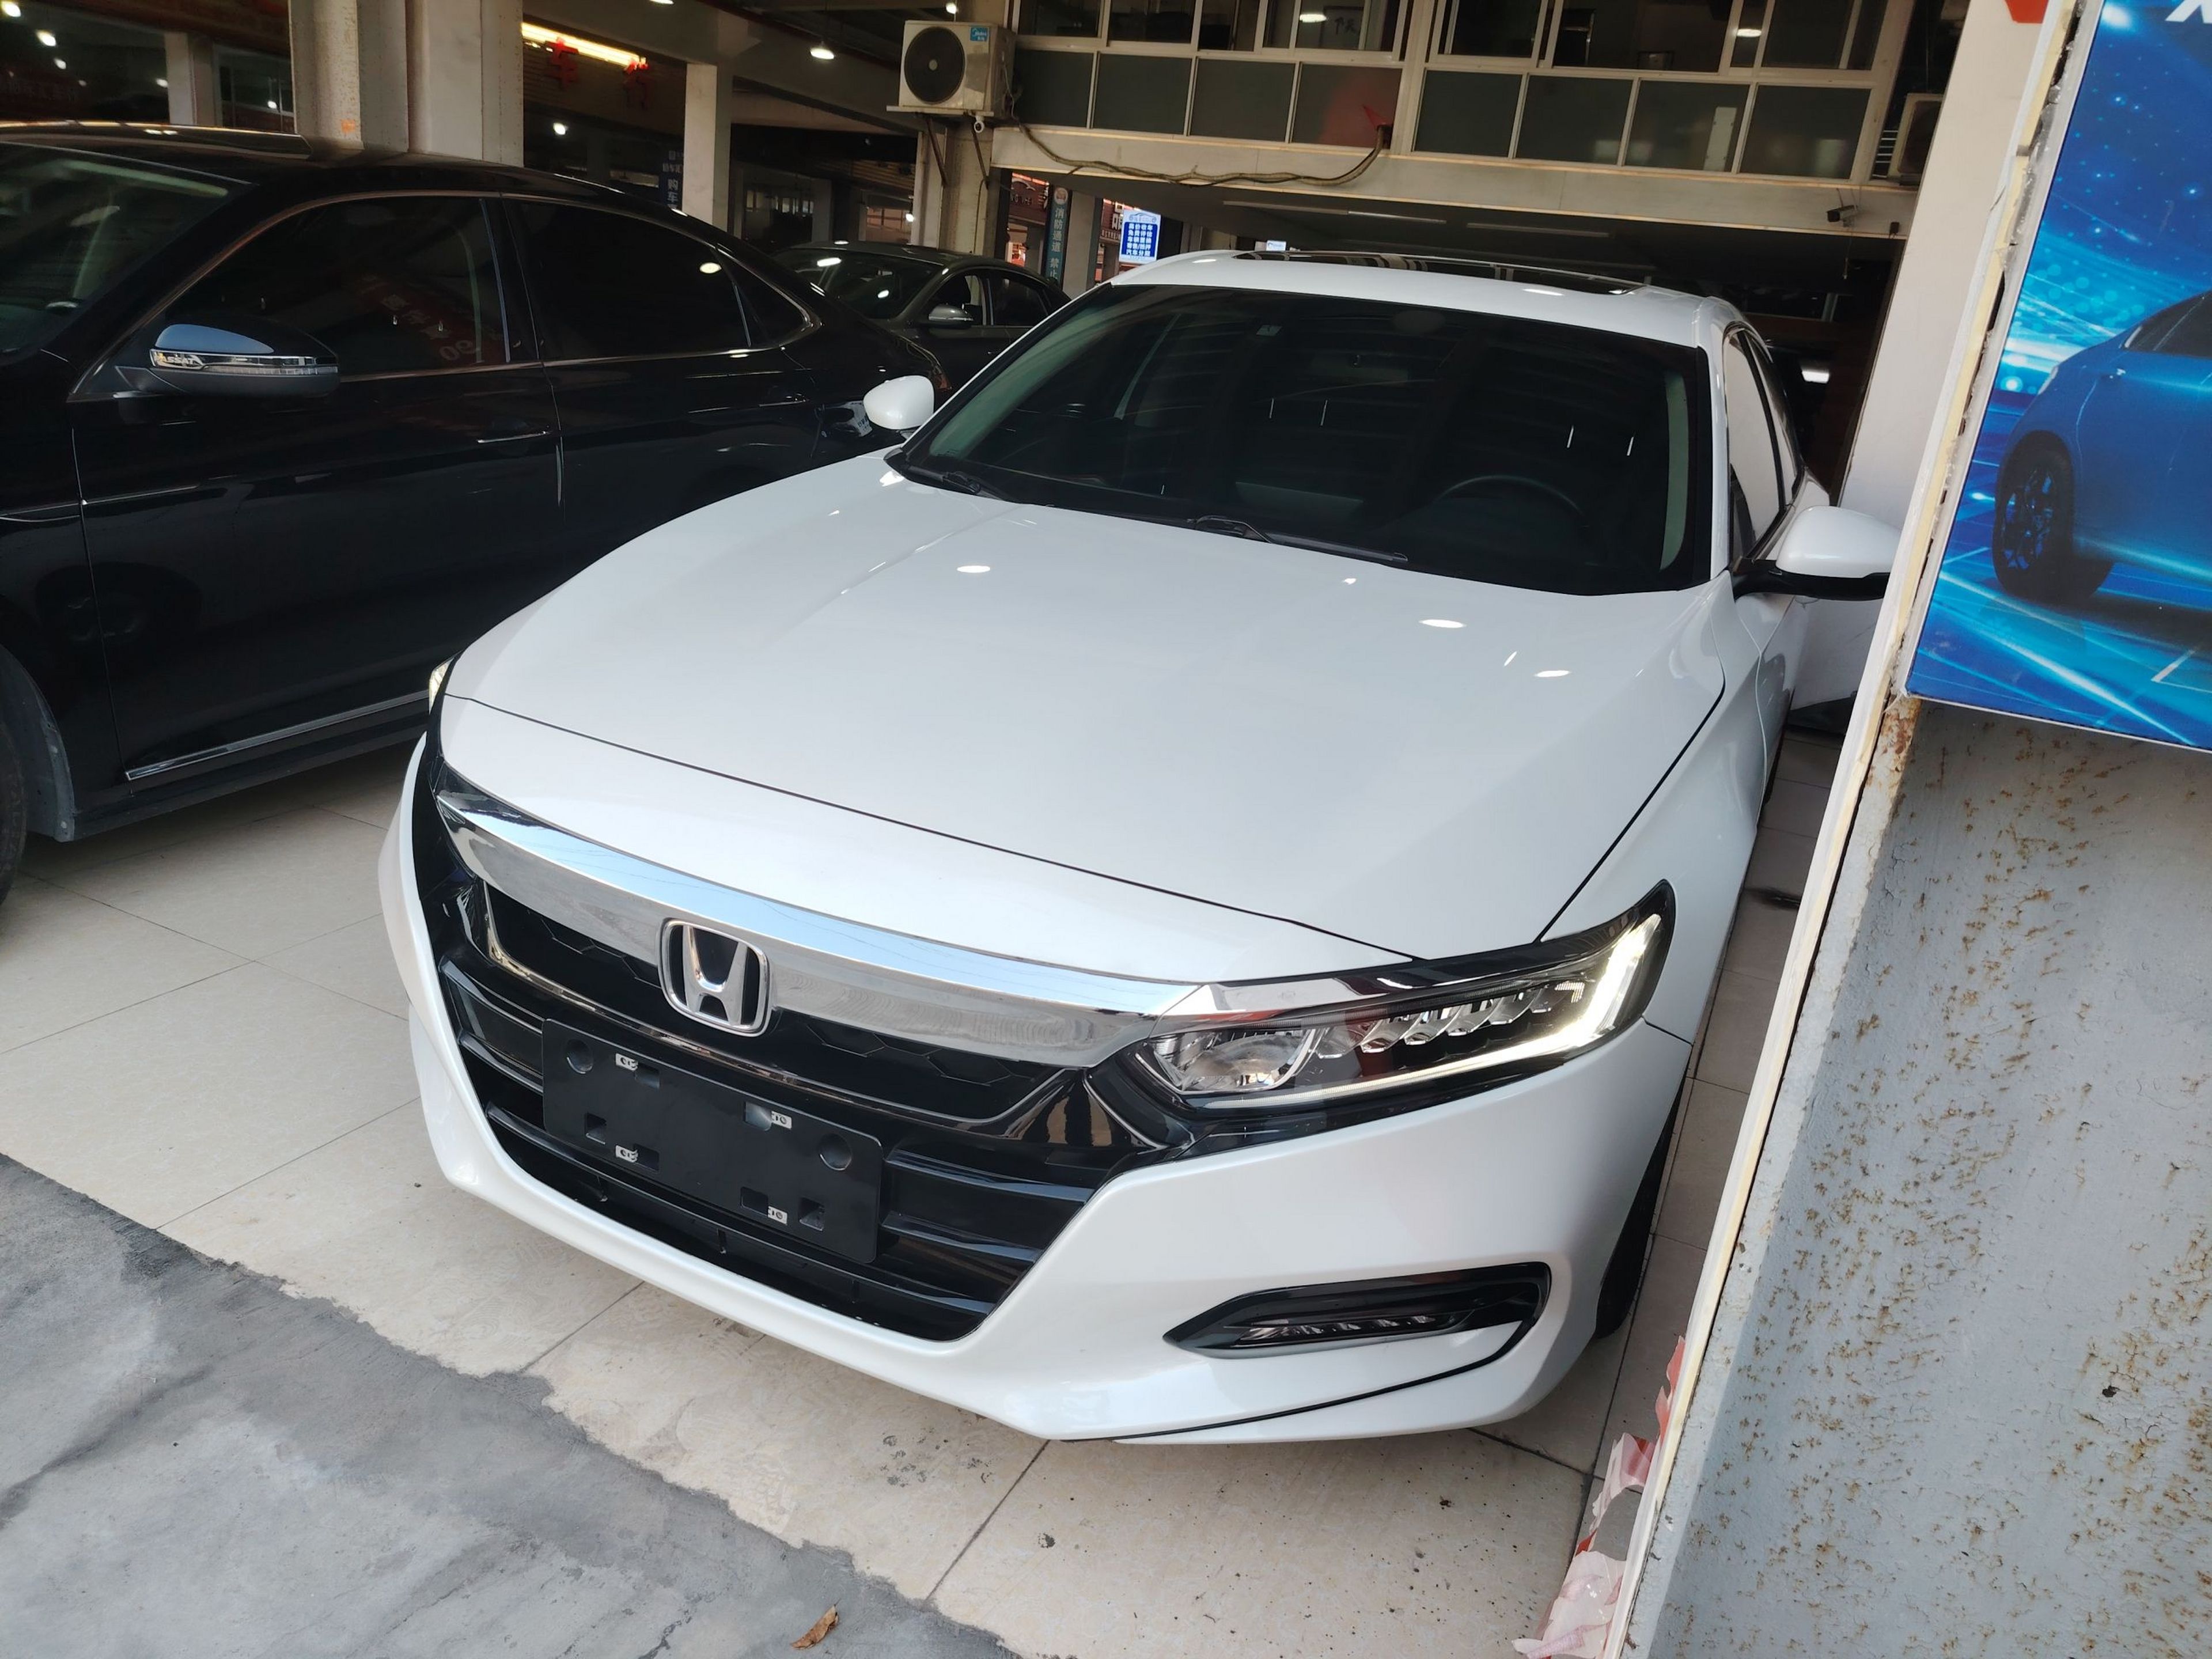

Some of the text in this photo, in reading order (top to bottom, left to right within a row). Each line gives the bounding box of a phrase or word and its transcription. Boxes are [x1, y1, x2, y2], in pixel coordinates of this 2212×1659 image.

[1050, 207, 1065, 279] 消防通道 禁止
